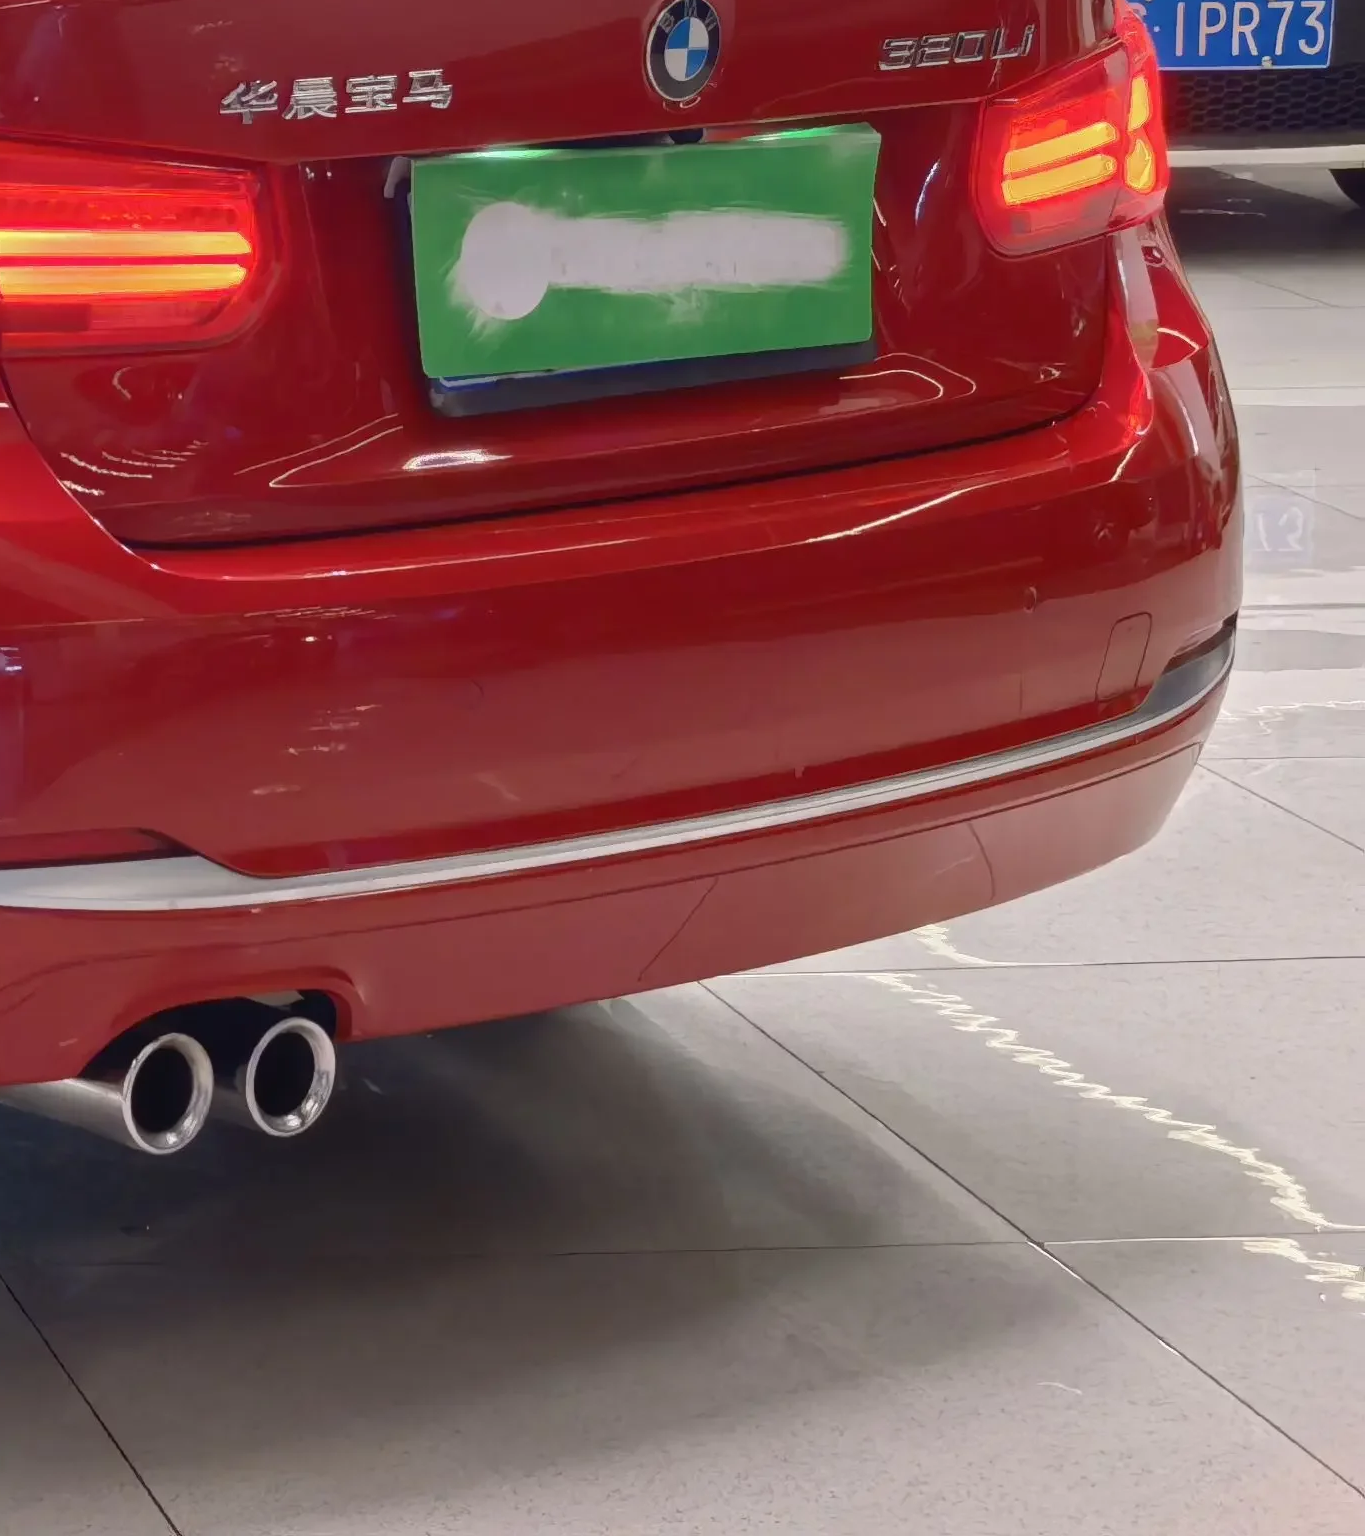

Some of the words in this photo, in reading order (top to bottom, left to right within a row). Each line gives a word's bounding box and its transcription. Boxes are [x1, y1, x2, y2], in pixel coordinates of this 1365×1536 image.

[659, 0, 718, 33] BMW
[878, 24, 1035, 71] 320Li
[220, 69, 453, 124] 华晨宝马
